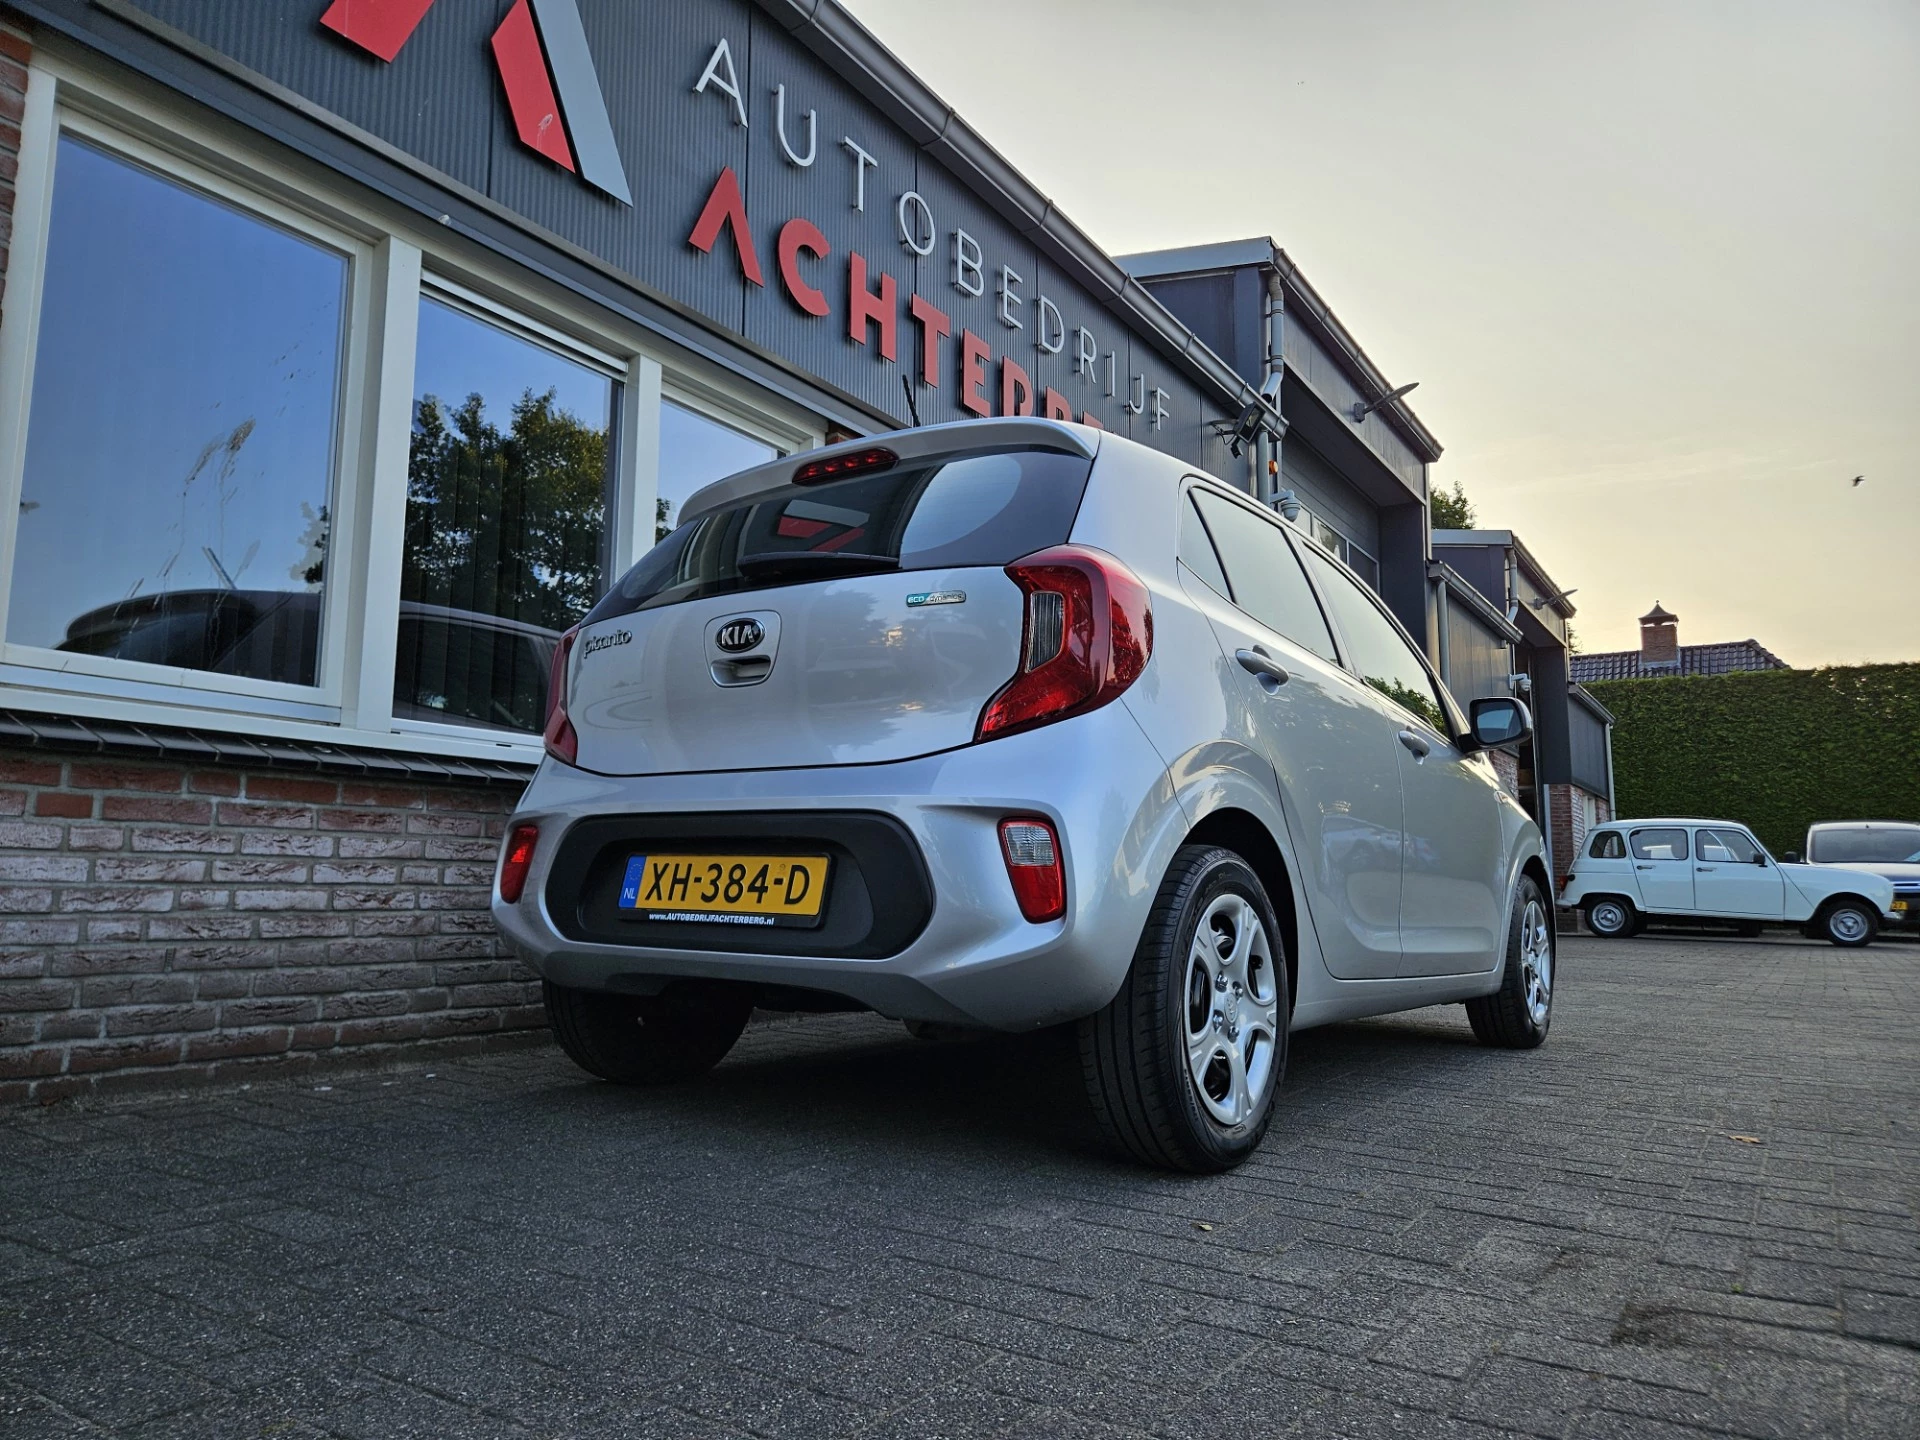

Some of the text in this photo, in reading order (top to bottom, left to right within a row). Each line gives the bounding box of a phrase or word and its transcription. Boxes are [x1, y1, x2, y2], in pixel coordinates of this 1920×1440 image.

[694, 38, 1170, 431] AUTOBEDRIJF
[584, 630, 632, 659] picanto
[721, 625, 755, 646] KIA
[623, 887, 636, 900] NL
[645, 863, 810, 905] XH-384-D
[649, 912, 775, 926] www.AUTOBEDRIJFACHTERBERG.nl
